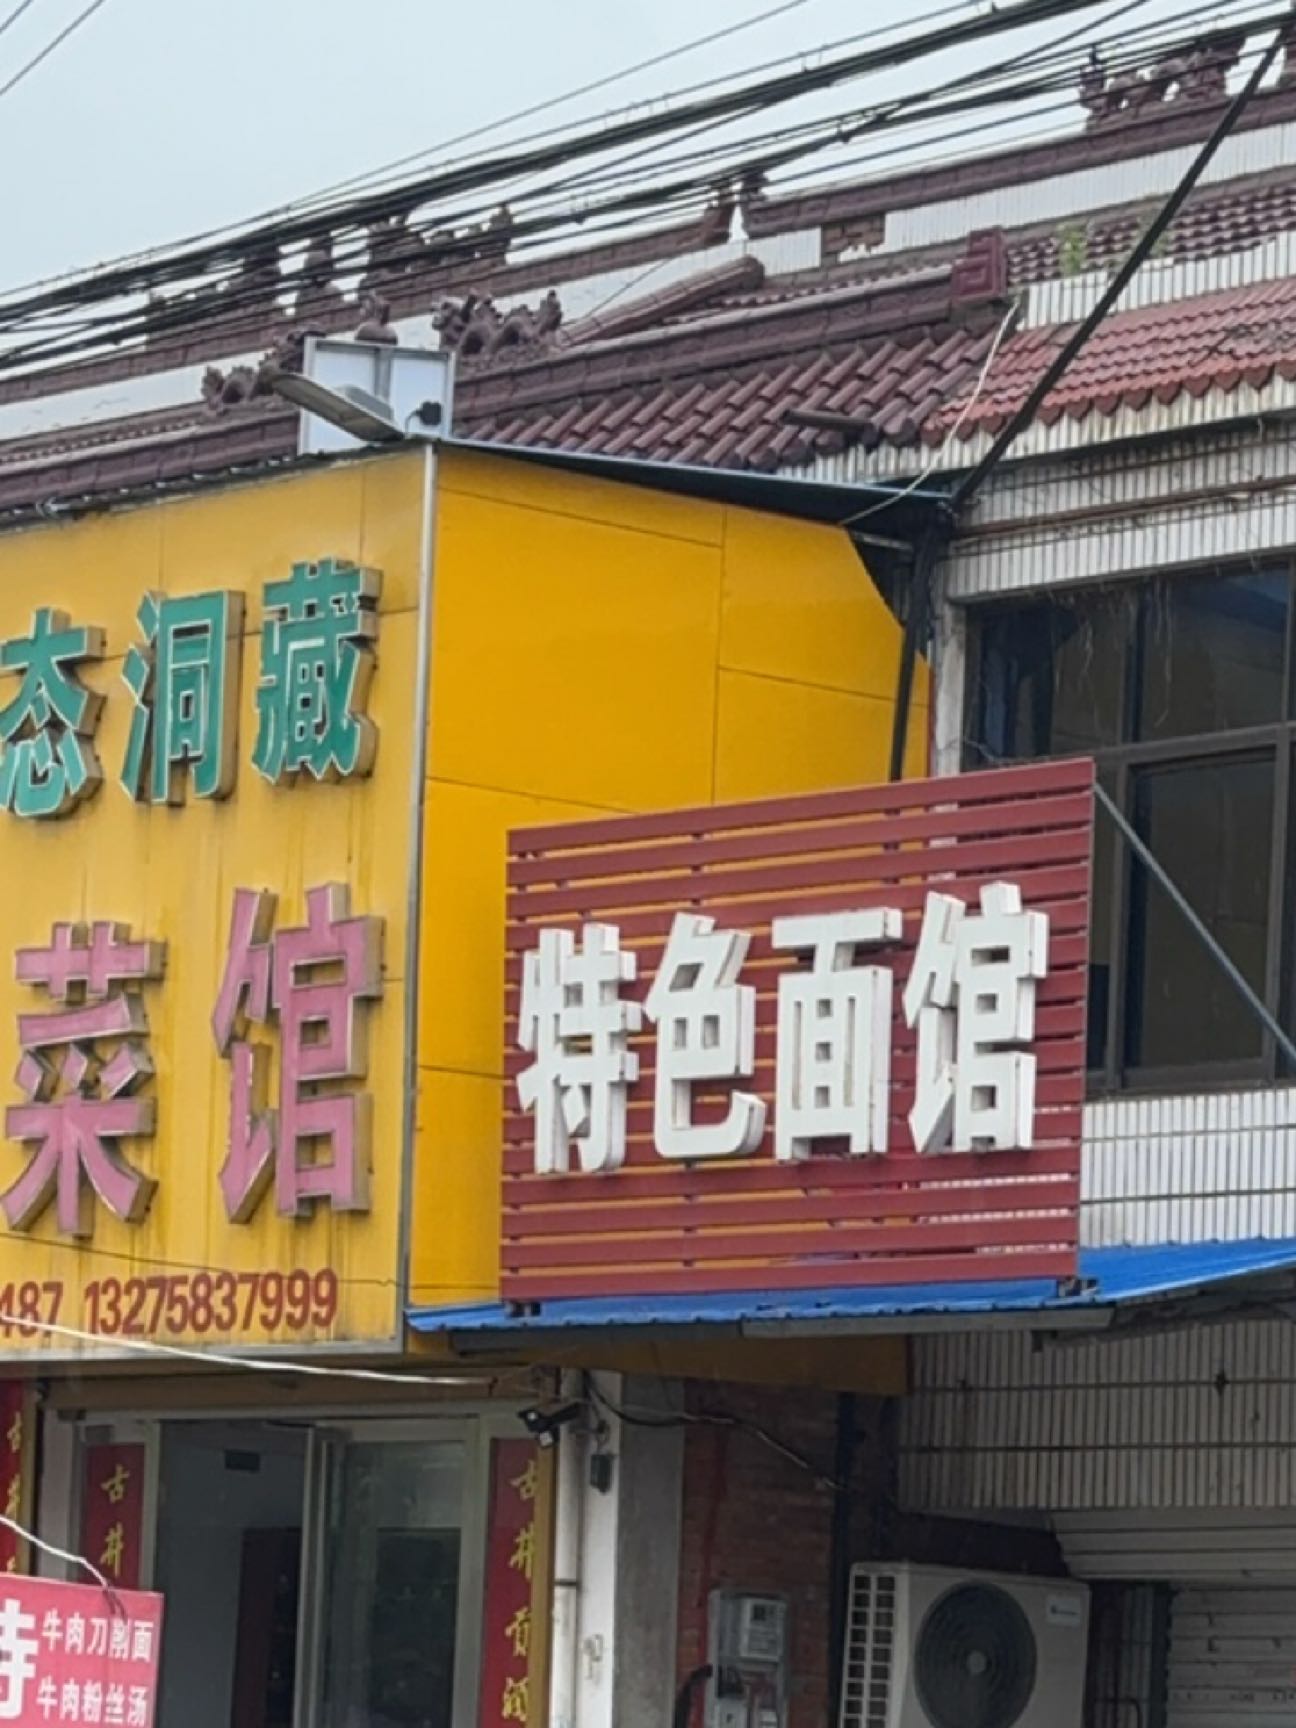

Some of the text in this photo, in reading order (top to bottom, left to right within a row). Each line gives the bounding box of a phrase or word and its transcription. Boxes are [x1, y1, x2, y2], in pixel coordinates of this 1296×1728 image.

[0, 556, 380, 818] 态洞藏
[5, 884, 382, 1235] 菜馆
[517, 882, 1048, 1174] 特色面馆
[84, 1268, 338, 1335] 13275837999
[36, 1675, 149, 1727] 牛肉粉丝汤
[41, 1607, 154, 1663] 牛肉刀削面
